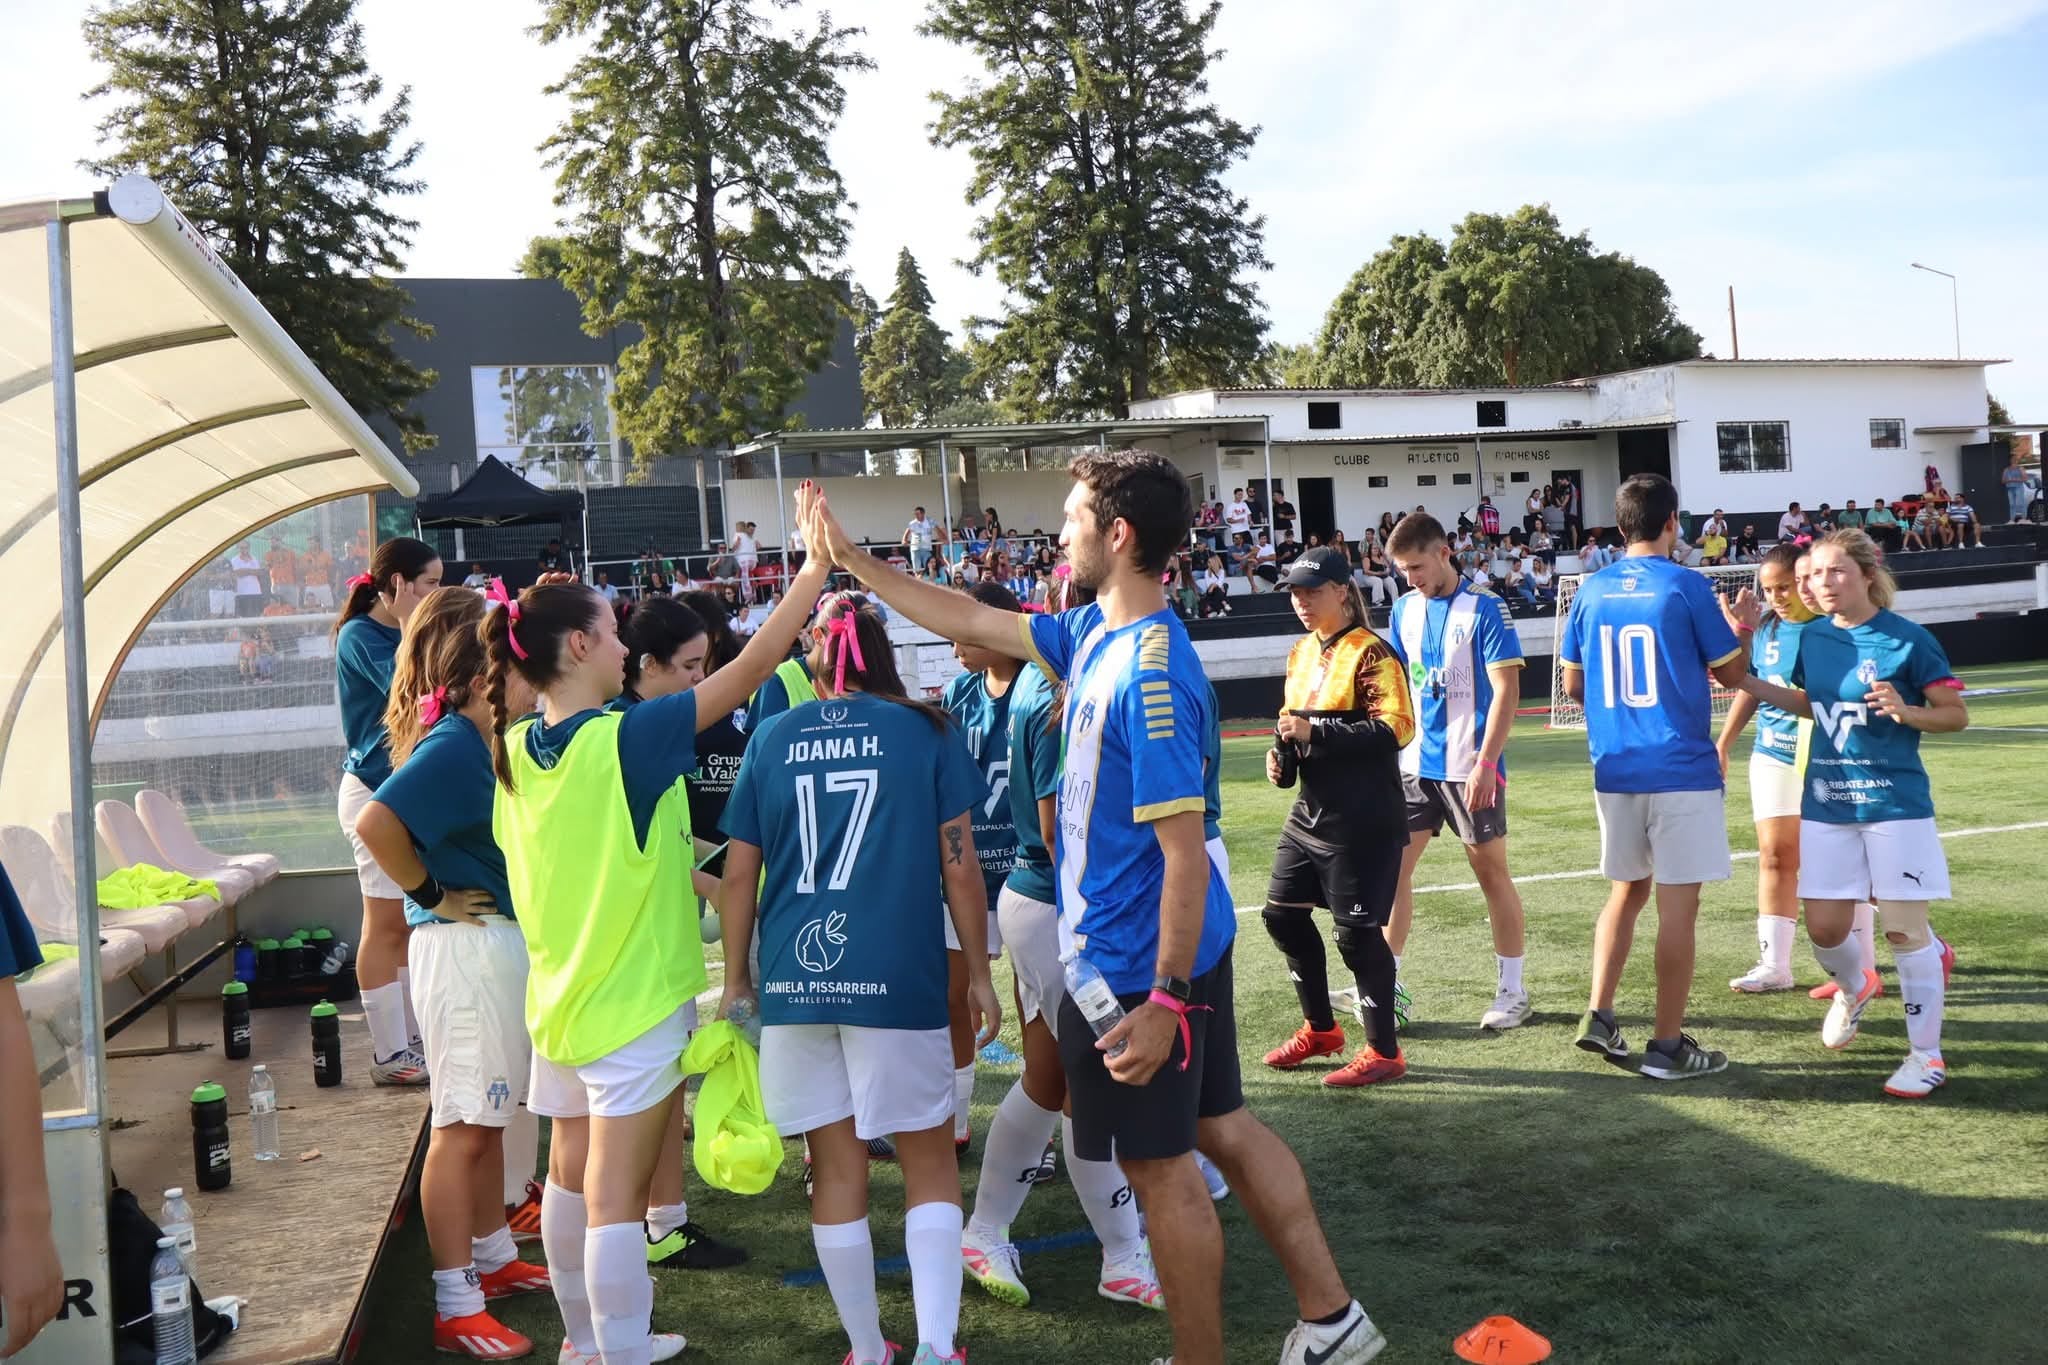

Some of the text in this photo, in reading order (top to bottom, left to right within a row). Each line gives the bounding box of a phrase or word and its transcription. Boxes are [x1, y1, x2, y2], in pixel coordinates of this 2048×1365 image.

[1334, 454, 1370, 465] CLUBE
[1764, 640, 1780, 666] 5
[1600, 624, 1658, 708] 10
[784, 735, 884, 765] JOANA H.
[1774, 740, 1797, 750] DIGIT
[707, 754, 744, 767] Grup
[1831, 791, 1867, 801] DIGITAL
[795, 769, 879, 894] 17
[976, 845, 1016, 859] IBATEJ
[981, 859, 1016, 870] IGITAL
[765, 981, 888, 995] DANIELA PISSARREIRA
[788, 996, 853, 1005] CABELEIREIRA
